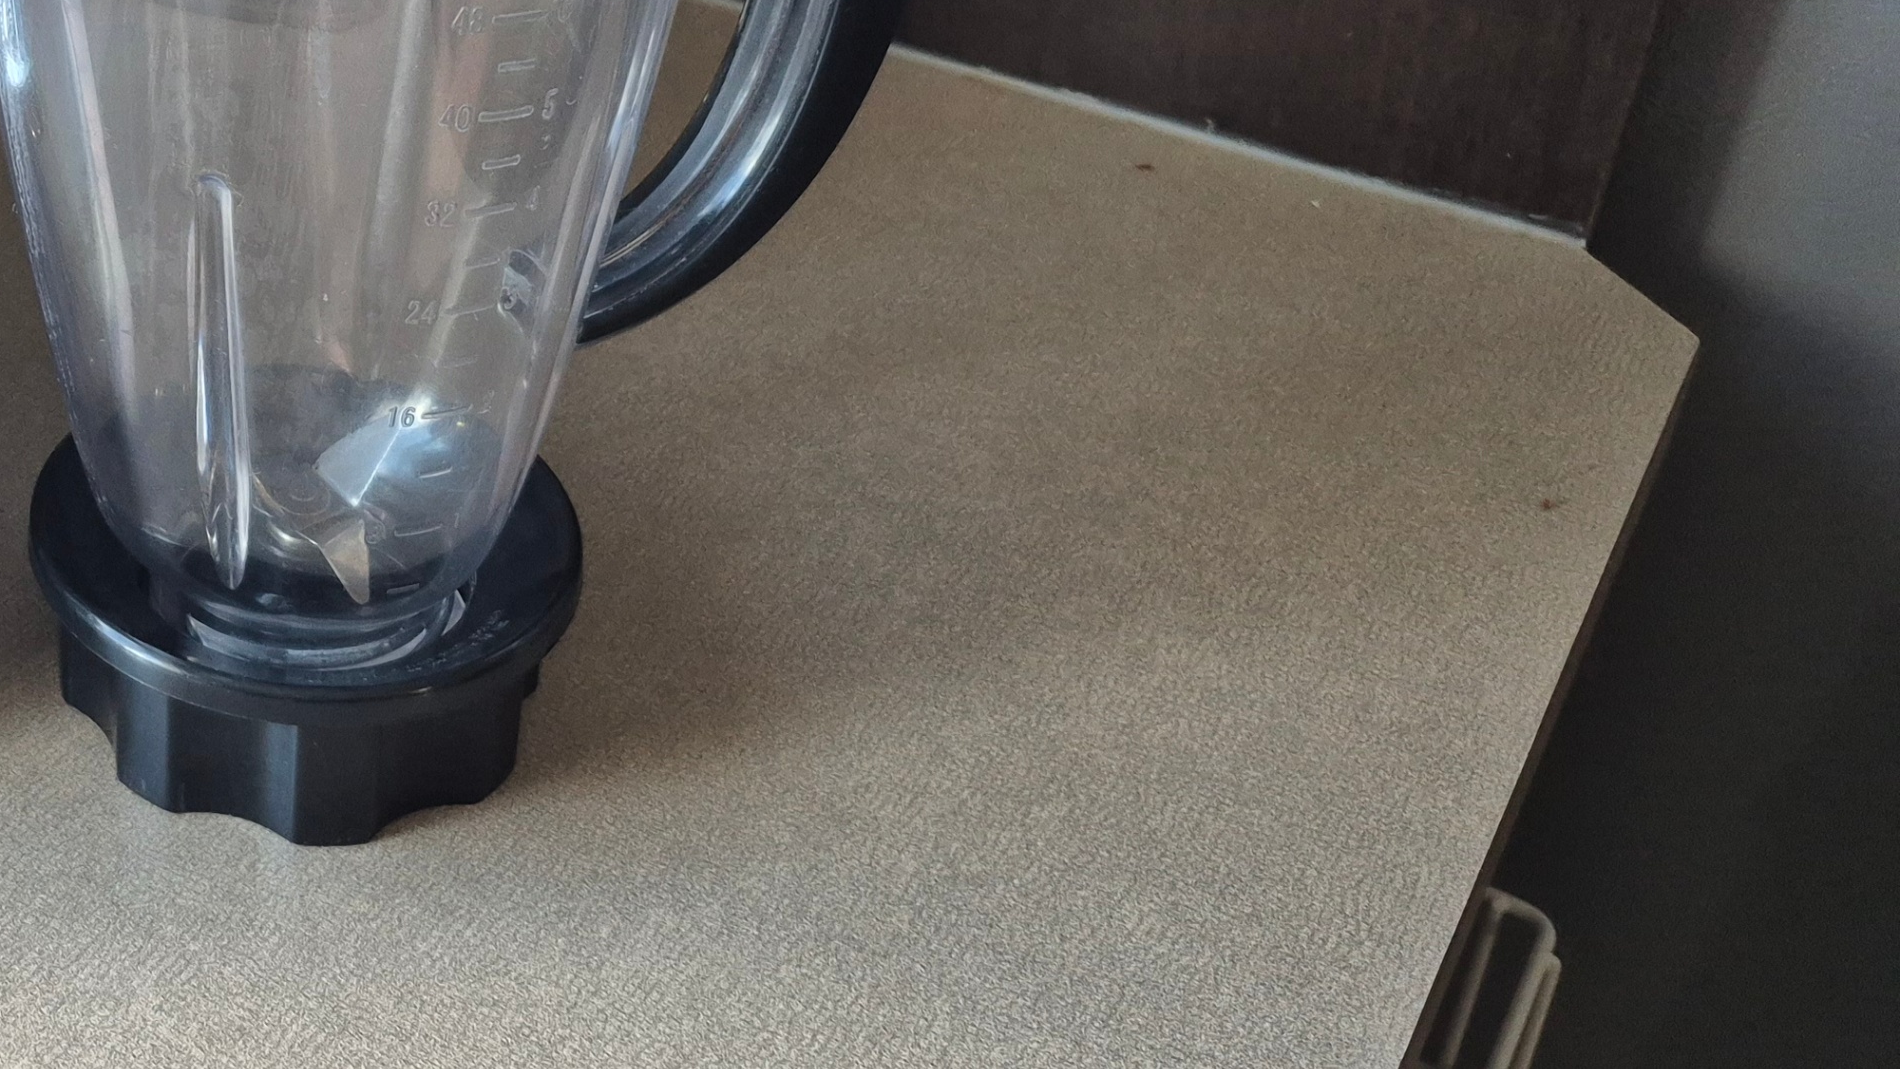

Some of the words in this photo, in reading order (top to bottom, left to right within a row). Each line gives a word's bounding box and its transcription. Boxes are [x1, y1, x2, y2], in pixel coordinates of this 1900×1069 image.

[541, 87, 560, 121] 5
[404, 300, 437, 326] 24
[388, 406, 417, 428] 16
